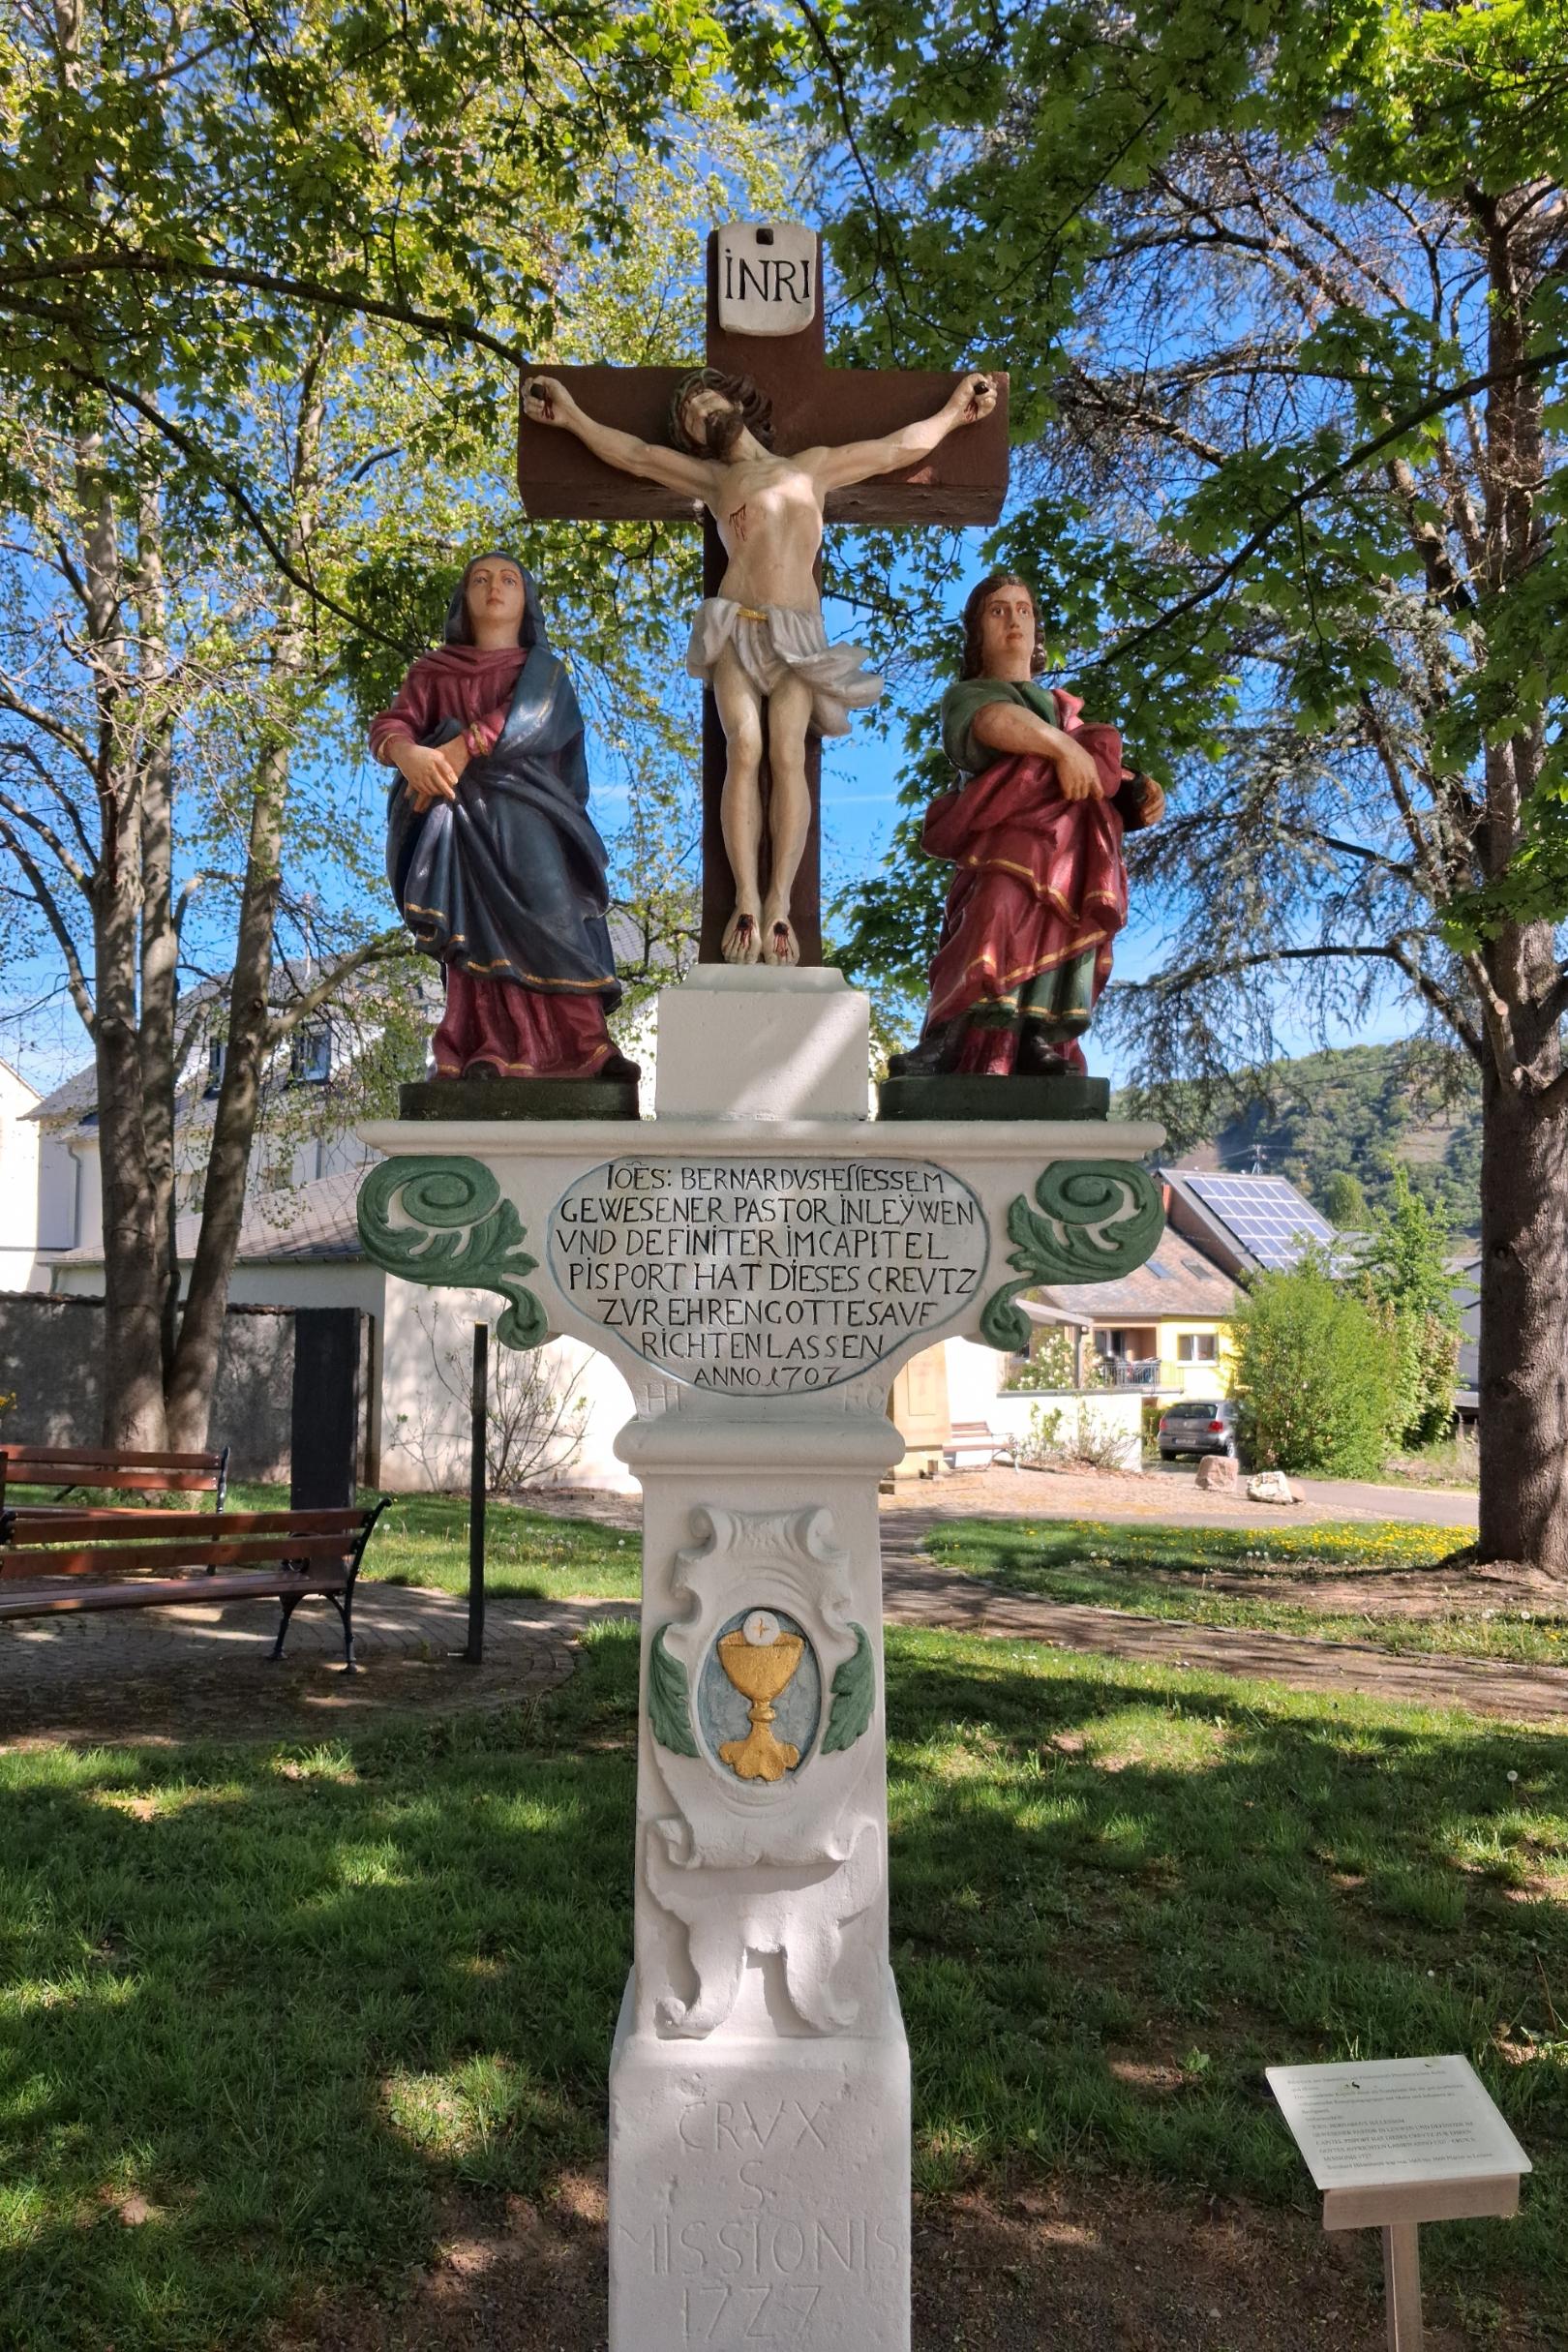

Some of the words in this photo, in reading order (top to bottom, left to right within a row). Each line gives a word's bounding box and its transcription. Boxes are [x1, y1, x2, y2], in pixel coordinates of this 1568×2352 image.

[560, 1196, 729, 1223] GEWESENER
[734, 1196, 835, 1226] PASTOR
[557, 1228, 617, 1255] VND
[694, 1262, 762, 1291] HAT
[868, 1266, 978, 1295] CREVTZ
[597, 1298, 664, 1326] ZVR
[669, 1298, 763, 1327] EHREN
[678, 2099, 829, 2152] CRVX
[739, 2159, 765, 2210] S
[617, 2215, 899, 2275] MISSIONIS
